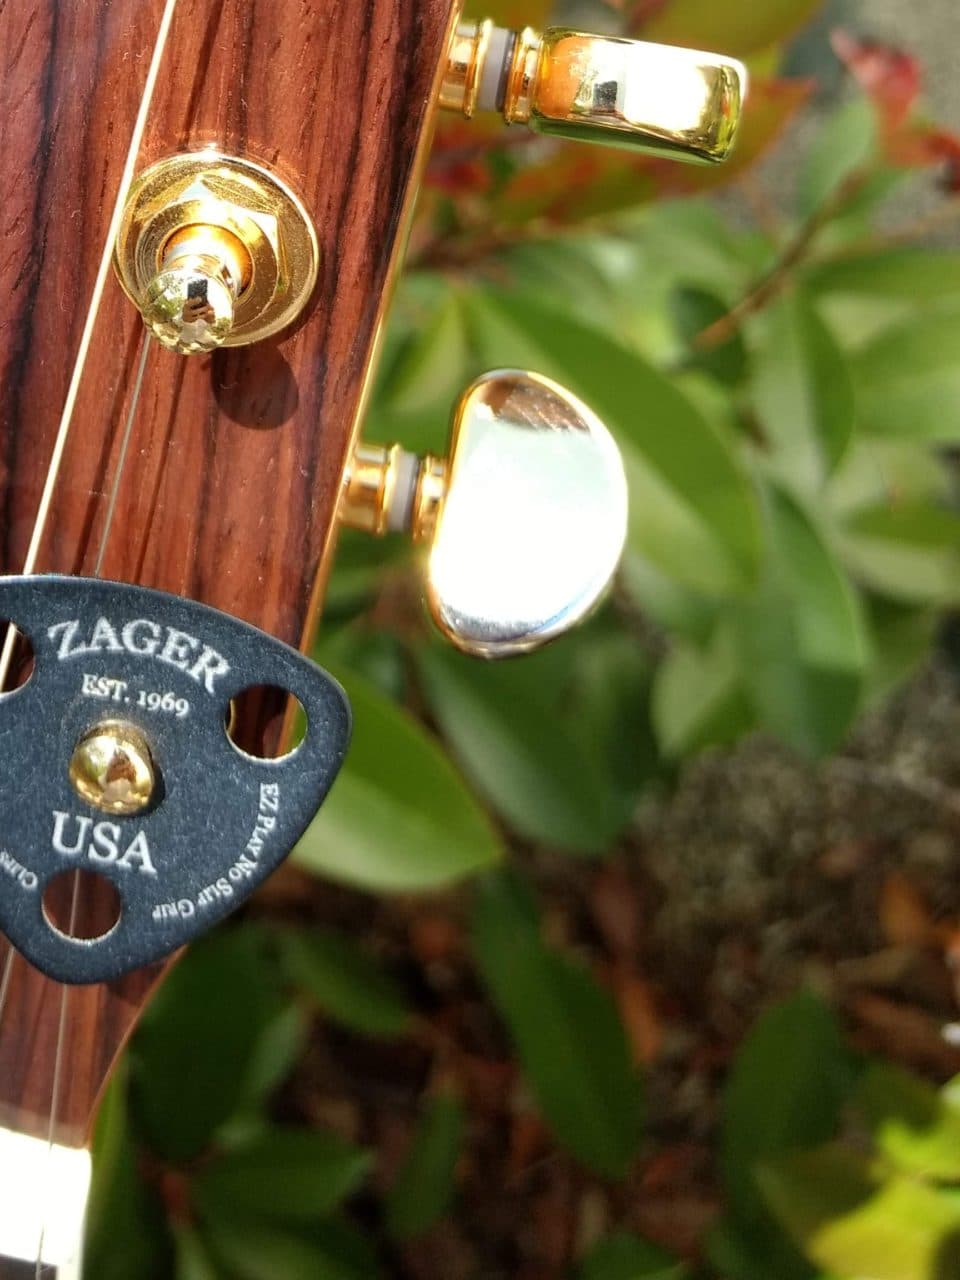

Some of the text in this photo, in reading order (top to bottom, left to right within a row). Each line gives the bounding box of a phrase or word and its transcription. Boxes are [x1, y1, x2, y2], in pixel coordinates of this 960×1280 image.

[47, 617, 231, 695] ZAGER
[82, 673, 189, 718] EST. 1969
[260, 783, 279, 811] EZ
[52, 810, 157, 877] USA
